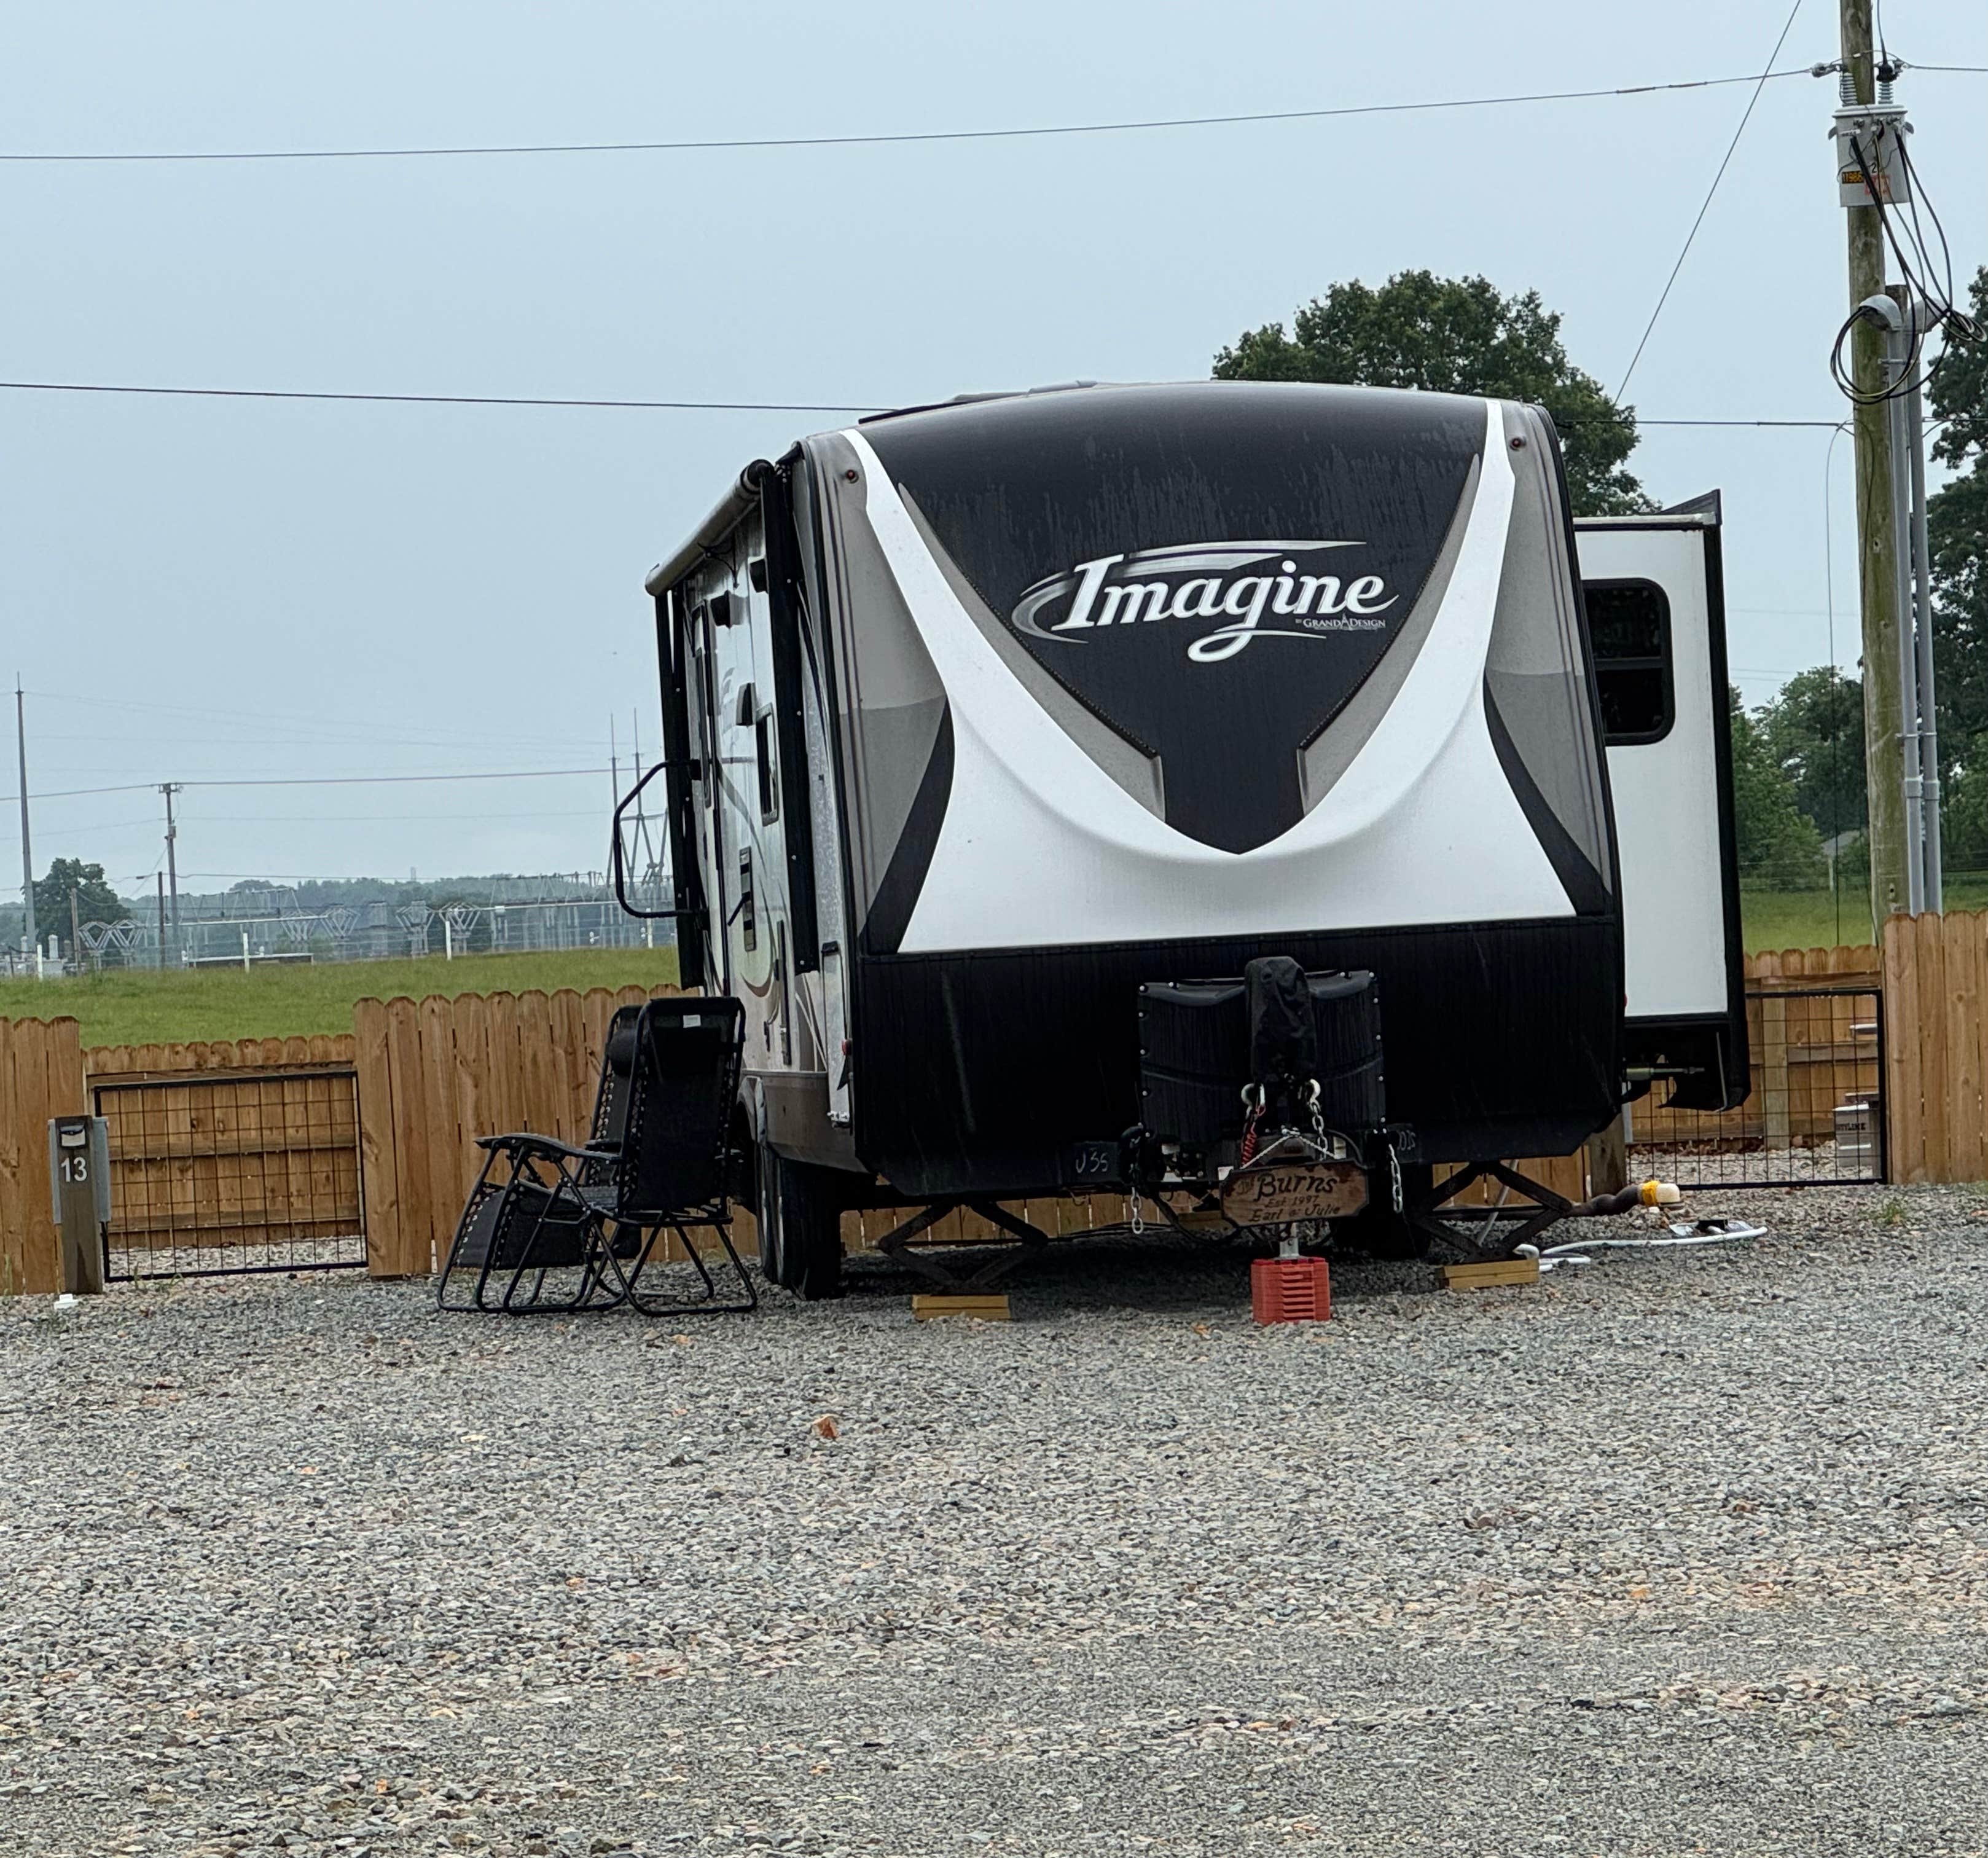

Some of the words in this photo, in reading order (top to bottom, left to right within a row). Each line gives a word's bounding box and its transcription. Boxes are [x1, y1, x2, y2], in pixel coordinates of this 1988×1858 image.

[1051, 554, 1399, 662] Imagine
[1303, 619, 1341, 628] GRAND
[1349, 619, 1386, 628] DESIGN
[61, 1156, 87, 1182] 13
[1253, 1172, 1337, 1201] Burns
[1248, 1209, 1283, 1222] Earl
[1305, 1204, 1340, 1216] Julie
